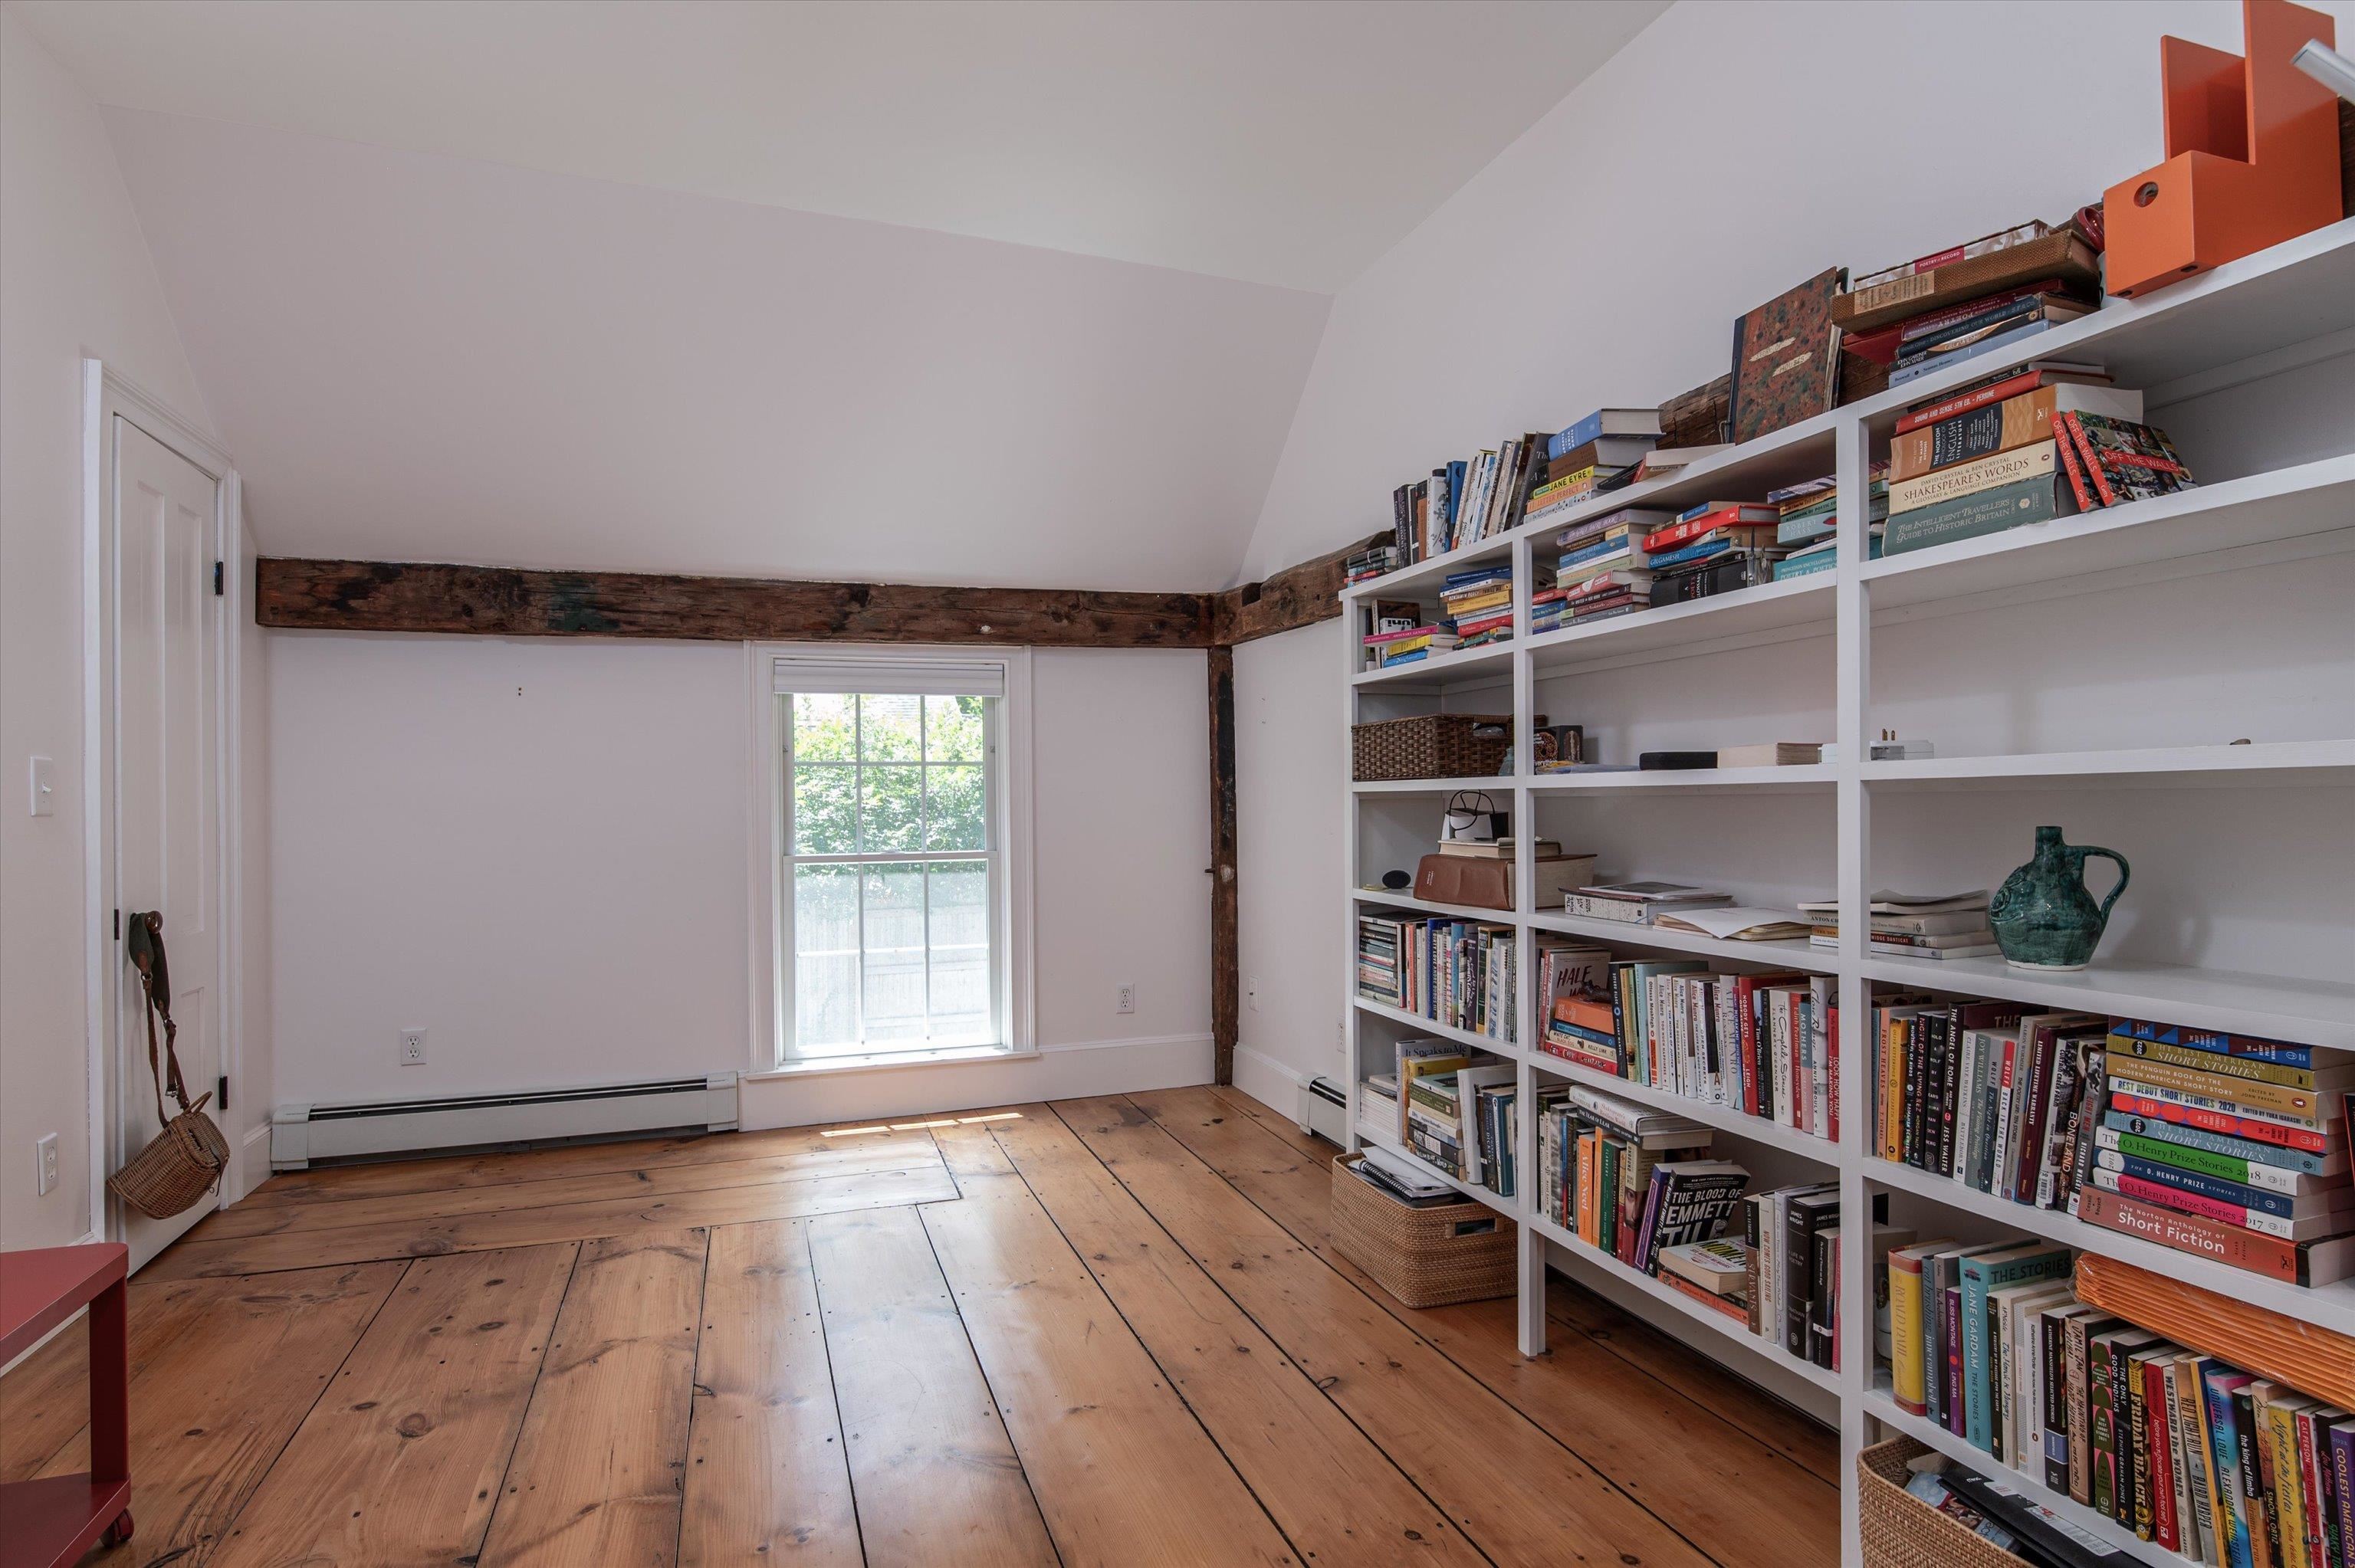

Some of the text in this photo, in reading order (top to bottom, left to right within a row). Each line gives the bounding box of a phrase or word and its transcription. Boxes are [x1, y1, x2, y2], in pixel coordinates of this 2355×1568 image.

[1913, 412, 1929, 424] SOUND
[1929, 409, 1939, 419] AND
[1939, 405, 1953, 416] SENSE
[1954, 401, 1963, 411] 5TH
[1963, 398, 1972, 408] ED.
[1976, 389, 1995, 403] PERRINE
[1946, 422, 1956, 462] ENGLISH
[2053, 420, 2077, 476] OFF THE WALLS
[2068, 418, 2097, 472] OFF THE WALLS
[1921, 476, 1939, 487] DAVID
[1940, 471, 1965, 482] CRYSTAL
[1971, 464, 1983, 473] BEN
[1984, 458, 2009, 468] CRYSTAL
[2104, 451, 2179, 472] OFF THE WALLS
[1549, 471, 1587, 490] JANE EYRE
[1557, 486, 1578, 499] PERFECT
[1903, 458, 2029, 501] SHAKESPEARE'S WORDS
[1897, 508, 2009, 544] GUIDE TO HISTORIC BRITAIN
[1898, 499, 2011, 533] THE INTELLIGENT TRAVELLER'S
[1650, 553, 1680, 566] GILGAMESH
[1405, 1048, 1411, 1057] It
[1414, 1045, 1439, 1056] Speaks
[1454, 1043, 1467, 1054] Me
[1948, 1053, 1955, 1064] OF
[1976, 1037, 1986, 1094] JOY WILLIAMS
[2156, 1052, 2199, 1067] SHORT
[2202, 1060, 2261, 1079] STORIES
[2117, 1068, 2232, 1096] MODERN AMERICAN SHORT STORY
[2140, 1064, 2170, 1075] PENGUIN
[2174, 1071, 2192, 1081] BOOK
[2118, 1080, 2134, 1089] BEST
[2137, 1084, 2158, 1097] DEBUT
[2160, 1089, 2183, 1102] SHORT
[2185, 1094, 2215, 1108] STORIES
[2219, 1100, 2236, 1112] 2020
[2242, 1107, 2258, 1116] EDITED
[2265, 1111, 2278, 1120] YUKA
[2278, 1114, 2301, 1124] IGARASHI
[2062, 1111, 2078, 1173] BONELAND
[2103, 1133, 2261, 1181] The O. Henry Prize Stories 2018
[2156, 1131, 2201, 1148] SHORT
[2204, 1142, 2265, 1163] STORIES
[2075, 1142, 2087, 1191] RICHARD WRIGHT
[1665, 1200, 1738, 1225] EMMETT
[1672, 1188, 1744, 1204] THE BLOOD OF
[2104, 1176, 2264, 1229] The O. Henry Prize Stories 2017
[1789, 1216, 1804, 1226] WRIGHT
[1790, 1210, 1803, 1219] JAMES
[2119, 1203, 2133, 1212] The
[2137, 1209, 2165, 1222] Norton
[2167, 1218, 2212, 1236] Anthology
[2117, 1211, 2225, 1255] Short Fiction
[1991, 1258, 2071, 1284] THE STORIES
[1967, 1284, 1979, 1370] JANE GARDAM
[2180, 1396, 2204, 1456] RED LIGHT RUN
[2209, 1388, 2228, 1461] UNIVERSAL LOVE
[2131, 1394, 2146, 1509] FRIDAY BLACK
[2192, 1475, 2212, 1530] BAIRD HARPER
[2336, 1447, 2355, 1559] COOLEST AMERICAN
